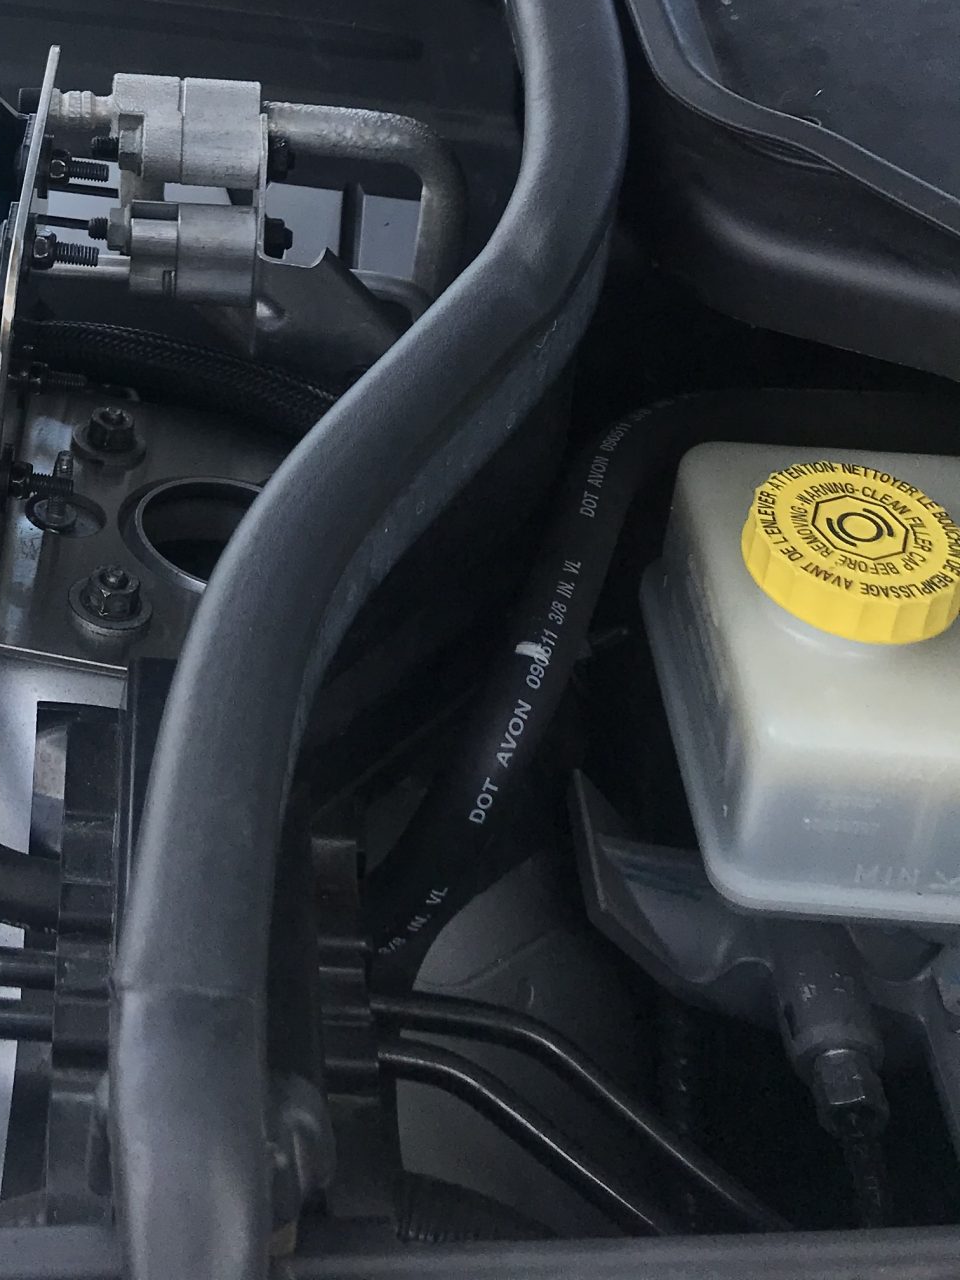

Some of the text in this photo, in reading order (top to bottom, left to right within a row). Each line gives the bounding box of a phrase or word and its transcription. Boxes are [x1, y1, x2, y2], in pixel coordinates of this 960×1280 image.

[587, 456, 610, 488] AVON
[841, 463, 918, 496] NETTOYER
[579, 491, 599, 518] DOT
[861, 486, 910, 515] CLEAN
[916, 491, 939, 510] LE
[790, 505, 835, 559] REMOVING
[903, 516, 933, 553] FILLER
[562, 559, 582, 576] VL
[780, 546, 804, 562] DE
[837, 557, 899, 576] BEFORE
[901, 551, 928, 572] CAP
[800, 561, 854, 591] AVANT
[859, 570, 955, 601] REMPLISSAGE
[556, 581, 576, 600] IN.
[548, 600, 568, 625] 3/8
[495, 699, 532, 768] AVON
[468, 776, 500, 825] DOT
[853, 863, 921, 887] MIN
[426, 886, 449, 906] VL
